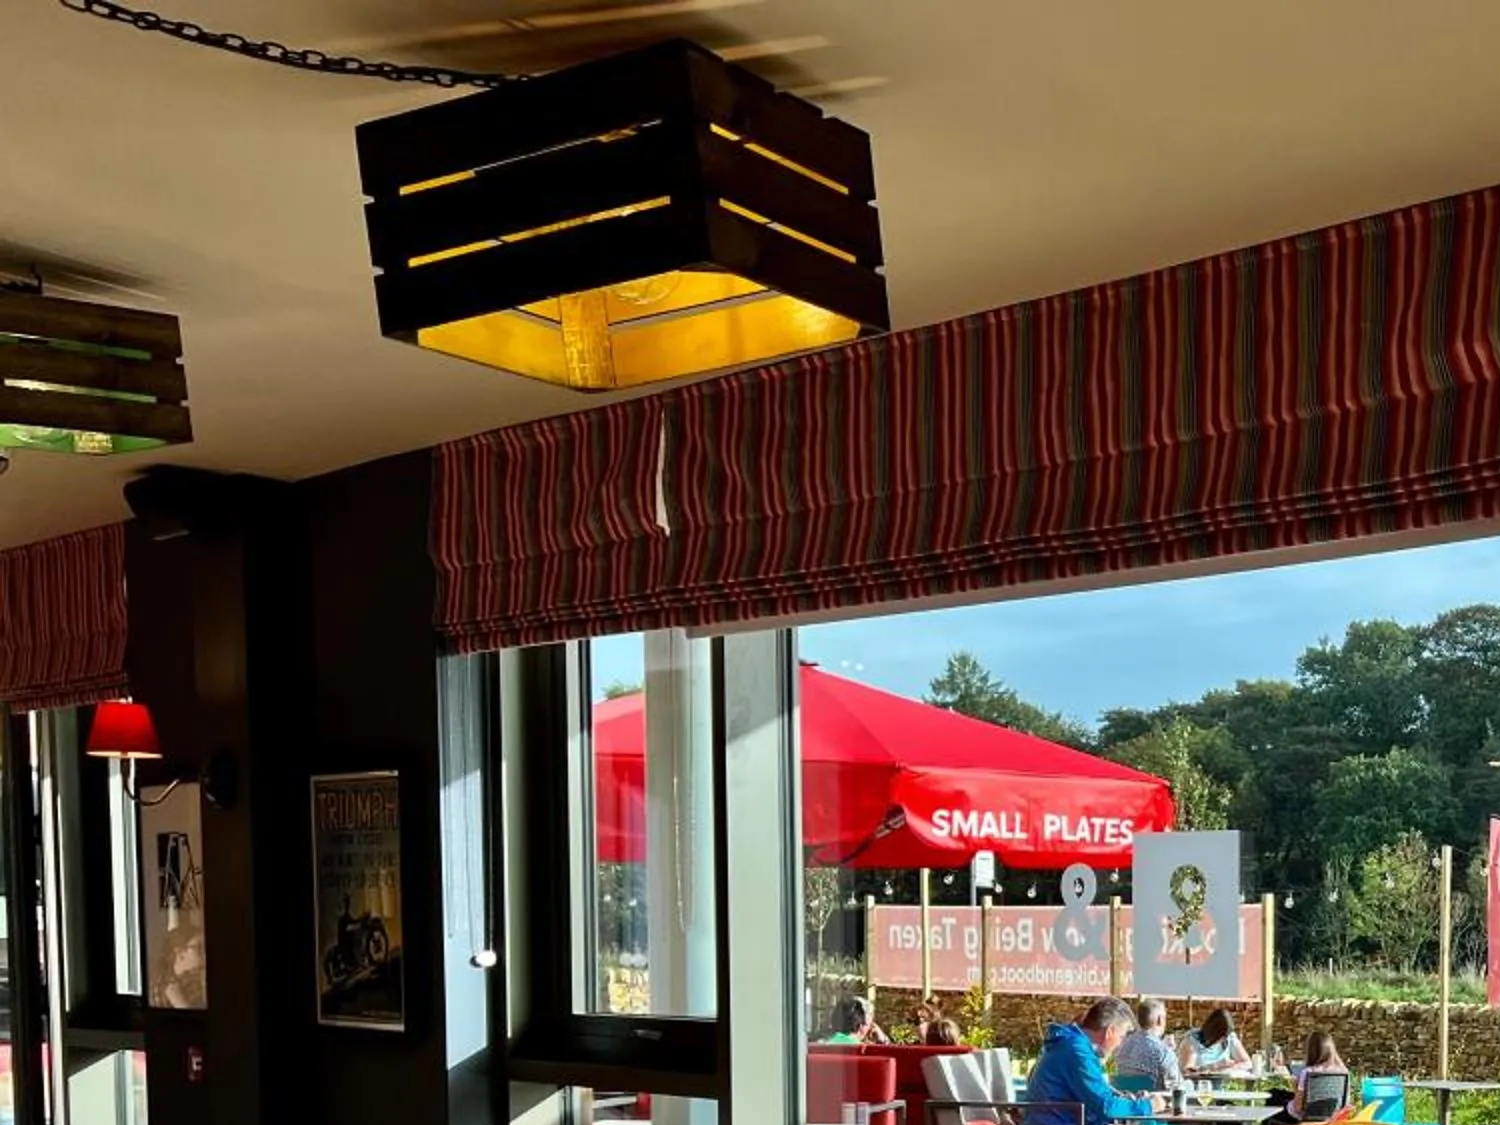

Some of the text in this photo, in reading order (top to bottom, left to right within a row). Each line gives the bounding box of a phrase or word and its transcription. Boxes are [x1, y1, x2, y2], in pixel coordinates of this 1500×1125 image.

[318, 791, 398, 831] TRIUMPH
[931, 809, 1134, 845] SMALL PLATES
